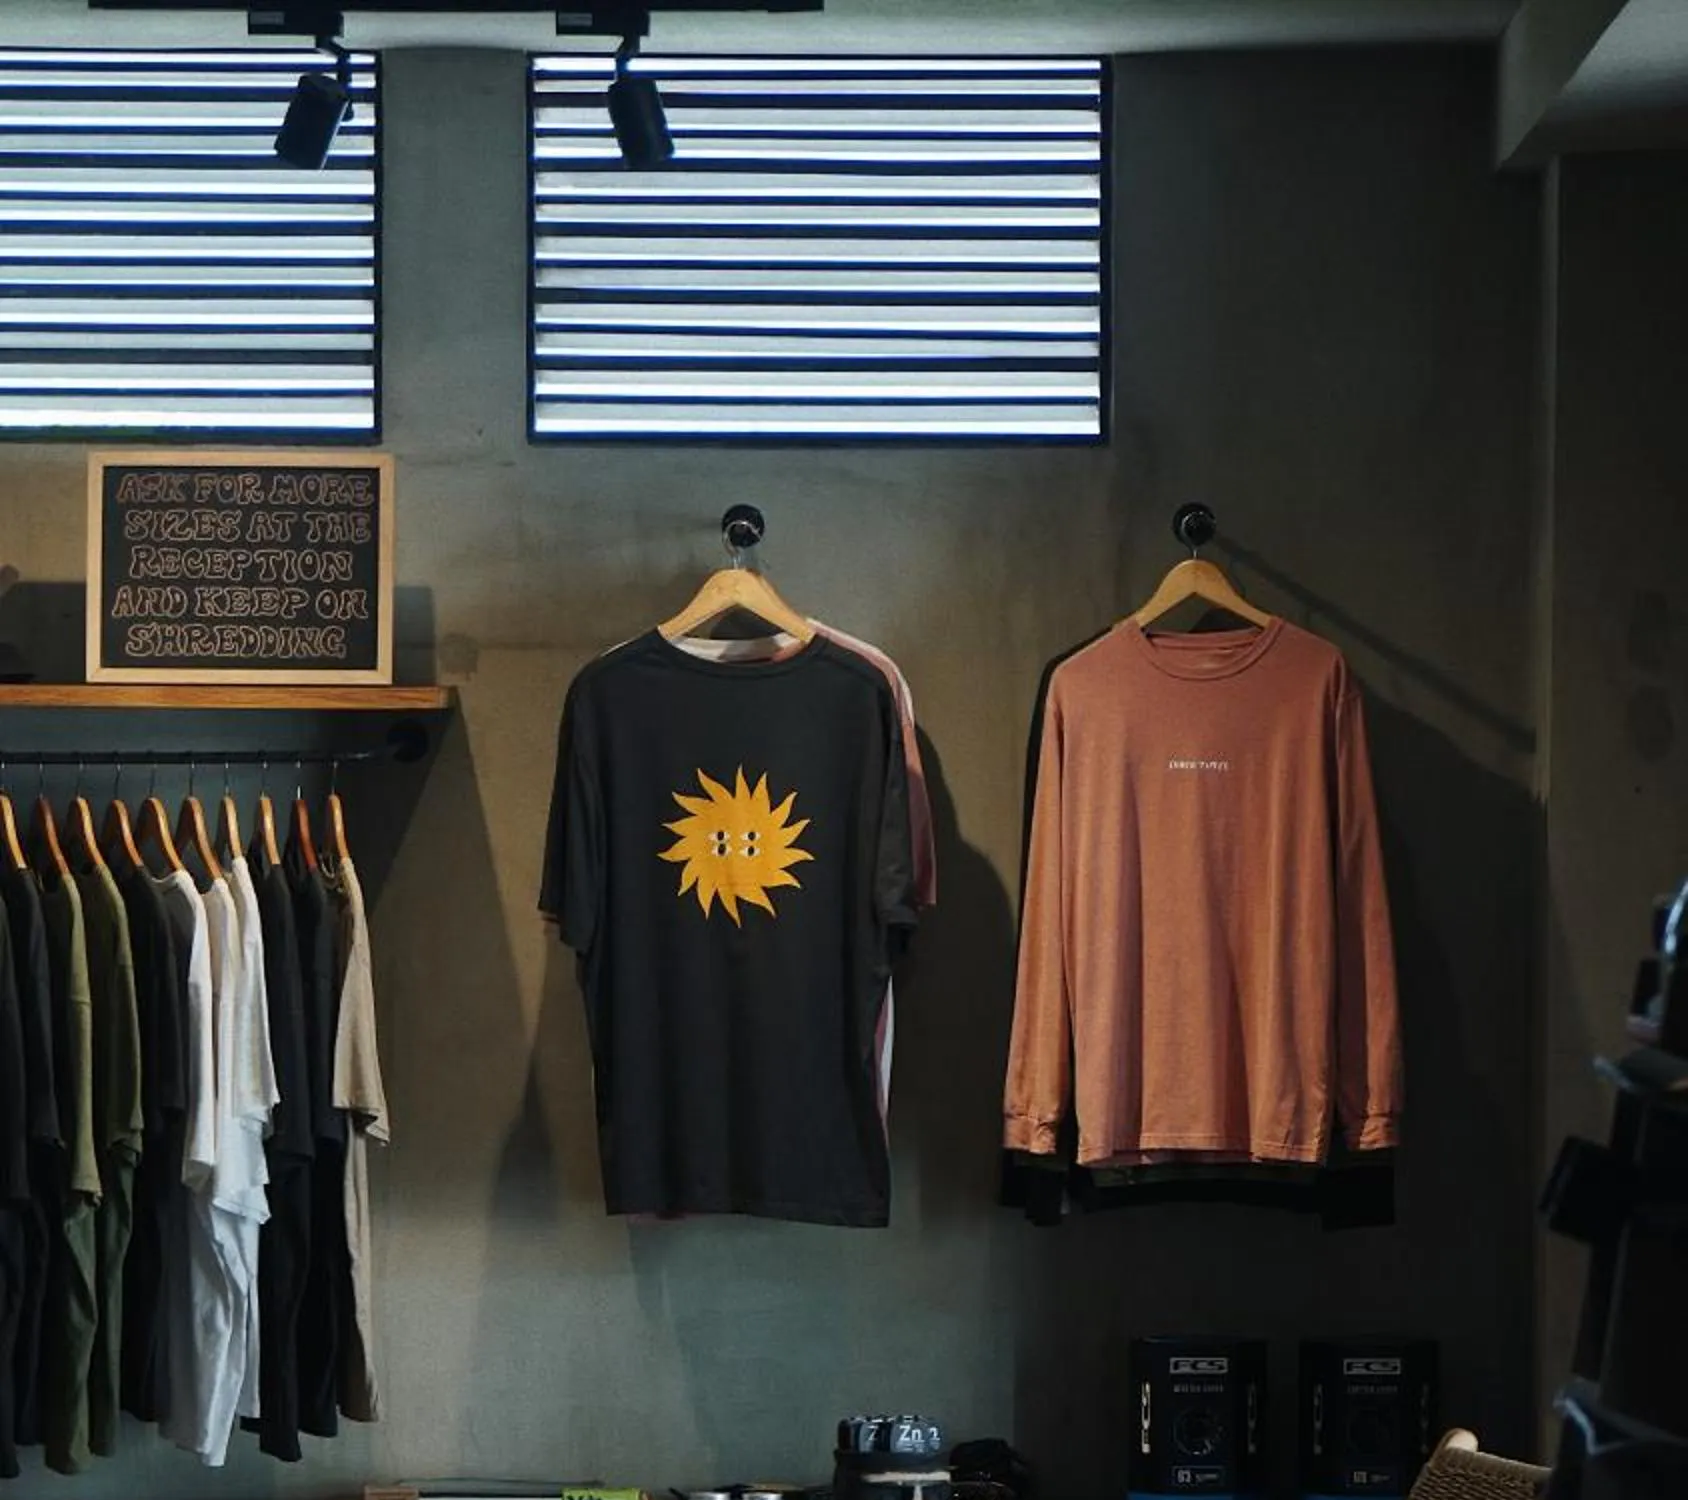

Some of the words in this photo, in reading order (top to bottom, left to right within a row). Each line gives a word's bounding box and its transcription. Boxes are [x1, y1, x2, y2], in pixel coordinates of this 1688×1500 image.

[116, 473, 190, 504] ASK
[194, 473, 264, 505] FOR
[268, 474, 374, 506] MORE
[124, 509, 242, 542] SIZES
[246, 511, 298, 543] AT
[303, 511, 371, 544] THE
[129, 545, 353, 582] RECEPTION
[112, 585, 187, 618] AND
[194, 586, 309, 619] KEEP
[315, 589, 369, 620] ON
[125, 621, 347, 659] SHREDDING
